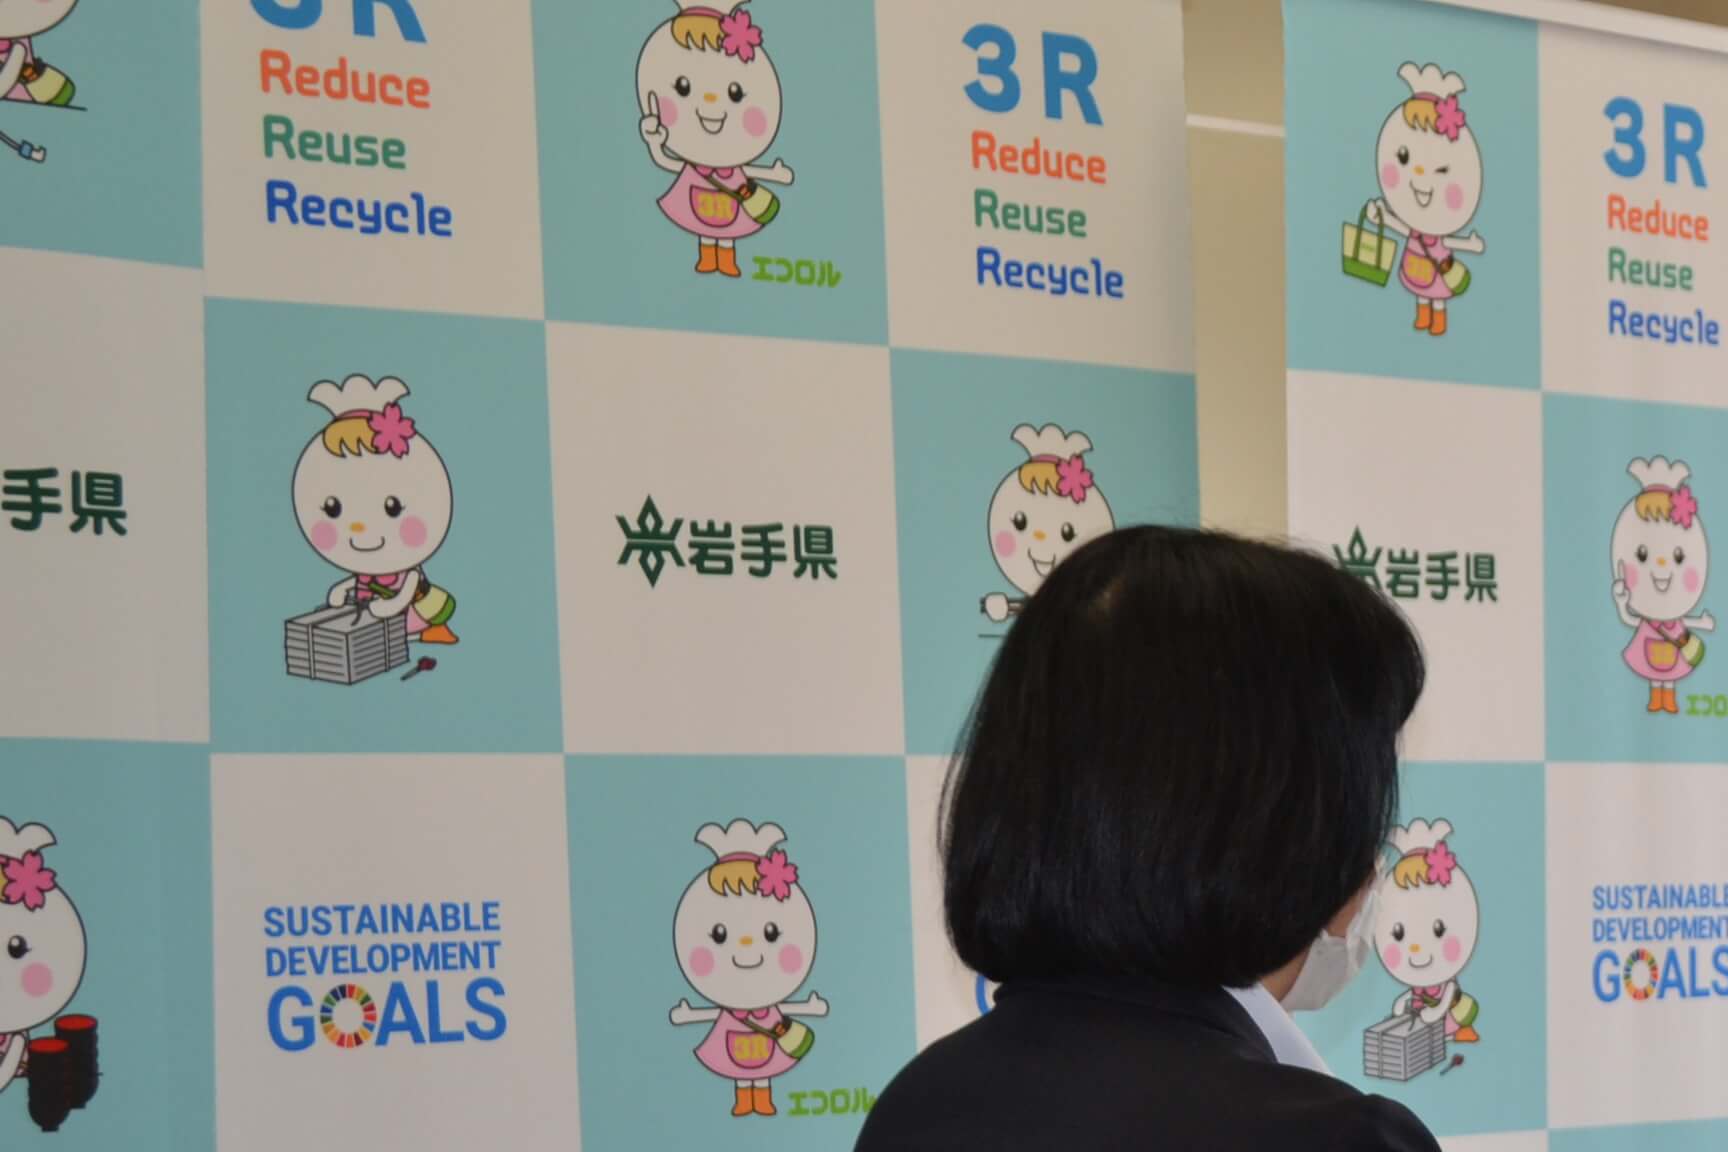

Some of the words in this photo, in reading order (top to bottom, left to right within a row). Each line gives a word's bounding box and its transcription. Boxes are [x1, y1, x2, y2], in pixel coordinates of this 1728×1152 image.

[261, 50, 431, 110] Reduce
[963, 25, 1104, 127] 3R
[264, 115, 407, 170] Reuse
[973, 132, 1107, 185] Reduce
[1605, 98, 1708, 189] 3R
[267, 181, 453, 238] Recycle
[975, 190, 1087, 239] Reuse
[1609, 195, 1709, 242] Reduce
[751, 255, 842, 289] エコロル
[978, 247, 1124, 299] Recycle
[1609, 248, 1694, 292] Reuse
[1610, 301, 1720, 346] Recycle
[689, 521, 839, 581] 岩手県
[1386, 548, 1498, 603] 岩手県
[263, 901, 502, 938] SUSTAINABLE
[265, 940, 503, 977] DEVELOPMENT
[267, 976, 508, 1053] GOALS
